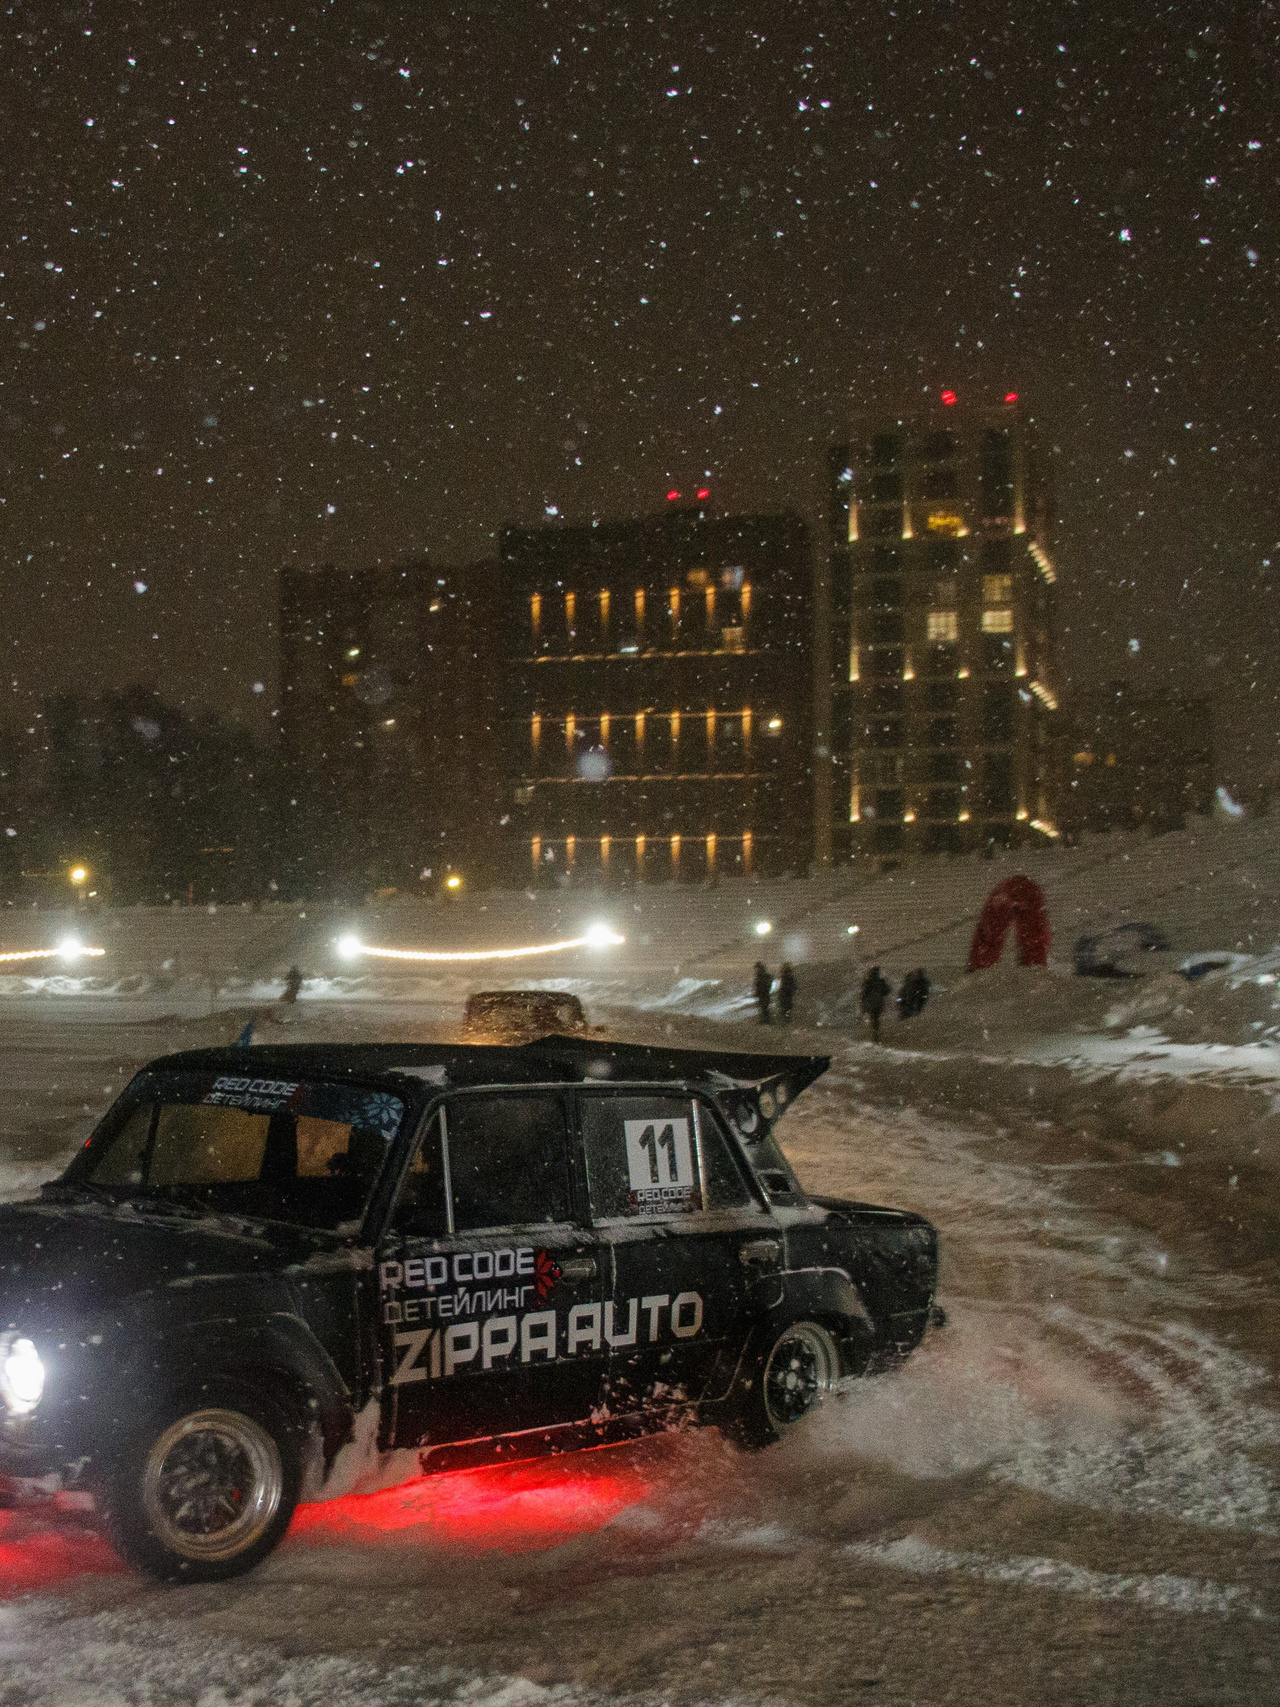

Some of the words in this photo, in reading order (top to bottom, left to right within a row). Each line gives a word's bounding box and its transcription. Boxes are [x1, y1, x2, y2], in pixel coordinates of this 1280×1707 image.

[212, 1077, 250, 1090] RED
[249, 1079, 299, 1096] CODE
[639, 1124, 678, 1183] 11
[637, 1188, 660, 1202] RED
[662, 1187, 692, 1199] CODE
[379, 1255, 448, 1291] RED
[454, 1247, 535, 1282] CODE
[383, 1285, 535, 1324] ДЕТЕЙЛИНГ
[391, 1310, 557, 1385] ZIPPA
[568, 1291, 703, 1354] AUTO
